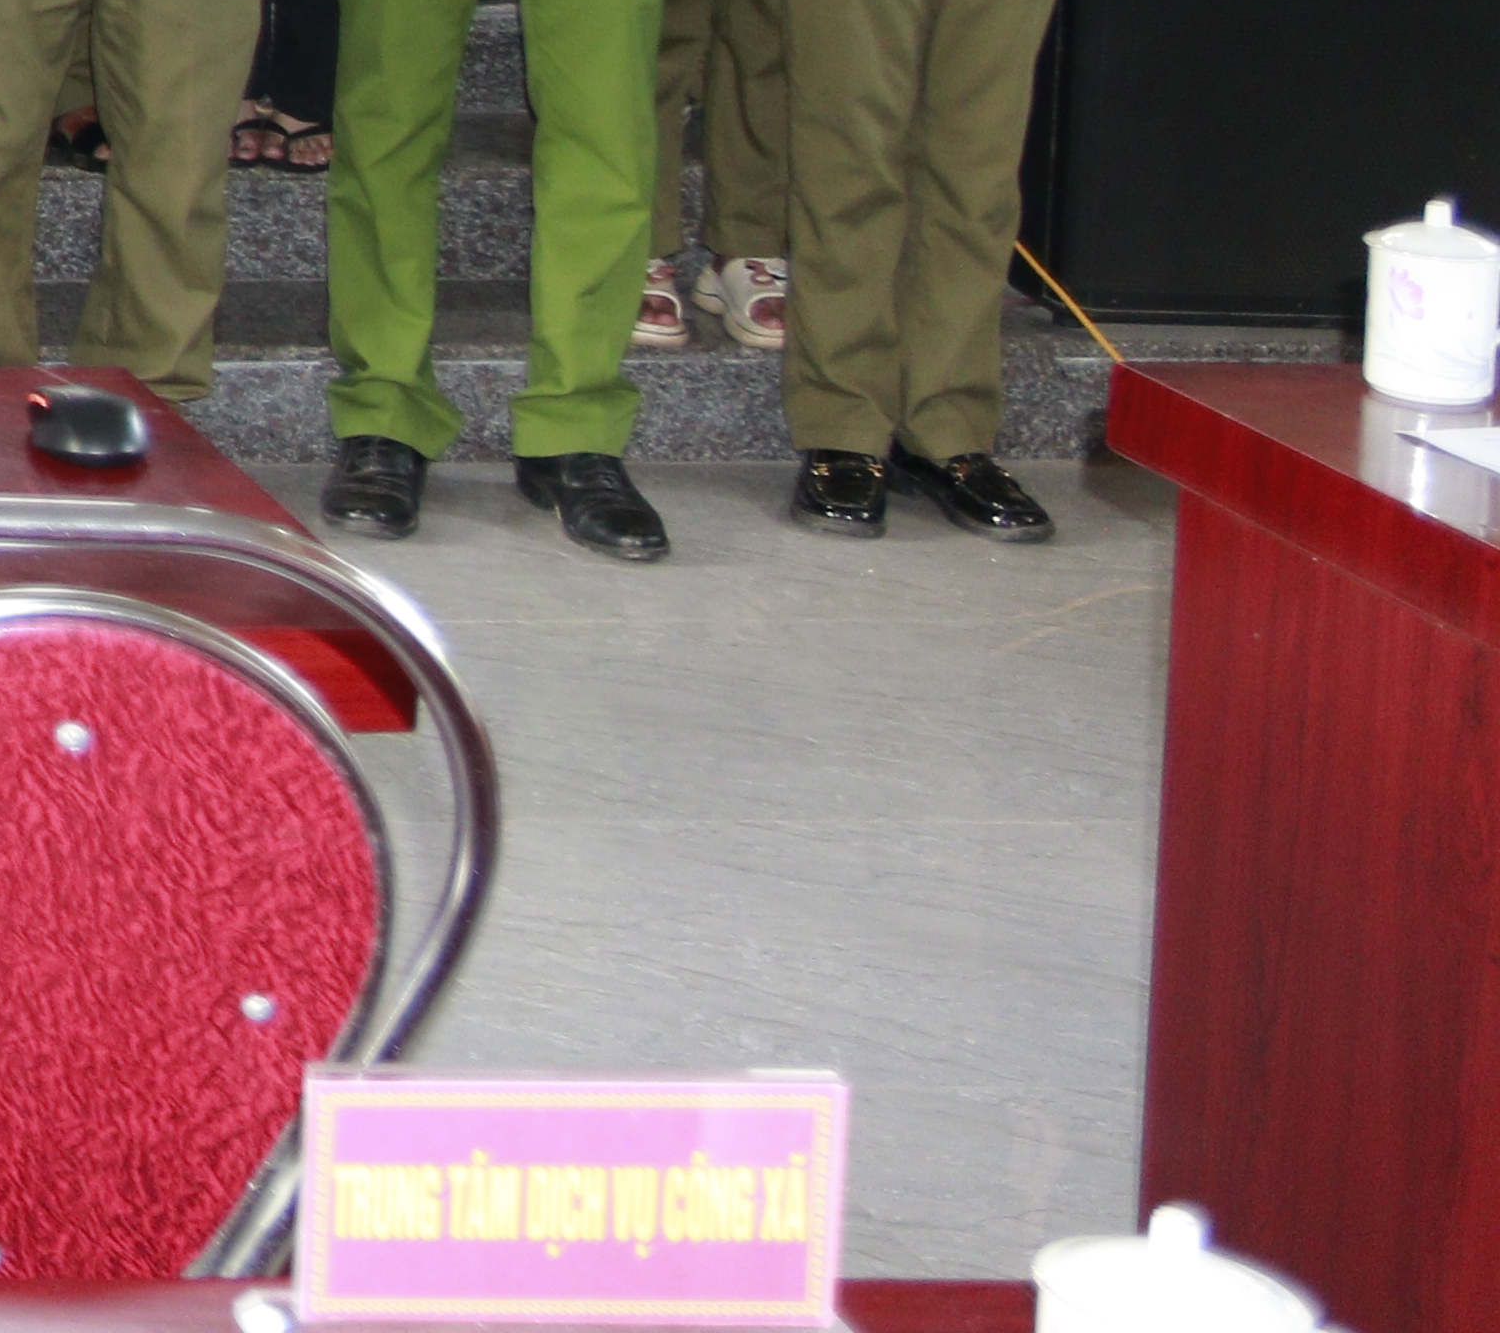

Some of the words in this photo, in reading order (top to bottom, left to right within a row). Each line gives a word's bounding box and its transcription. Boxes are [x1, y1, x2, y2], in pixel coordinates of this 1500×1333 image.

[334, 1164, 441, 1241] TRUNG
[448, 1149, 520, 1241] TÂM
[525, 1165, 608, 1258] DỊCH
[612, 1165, 658, 1258] VỤ
[663, 1150, 757, 1241] CÔNG
[761, 1152, 807, 1242] XÃ
